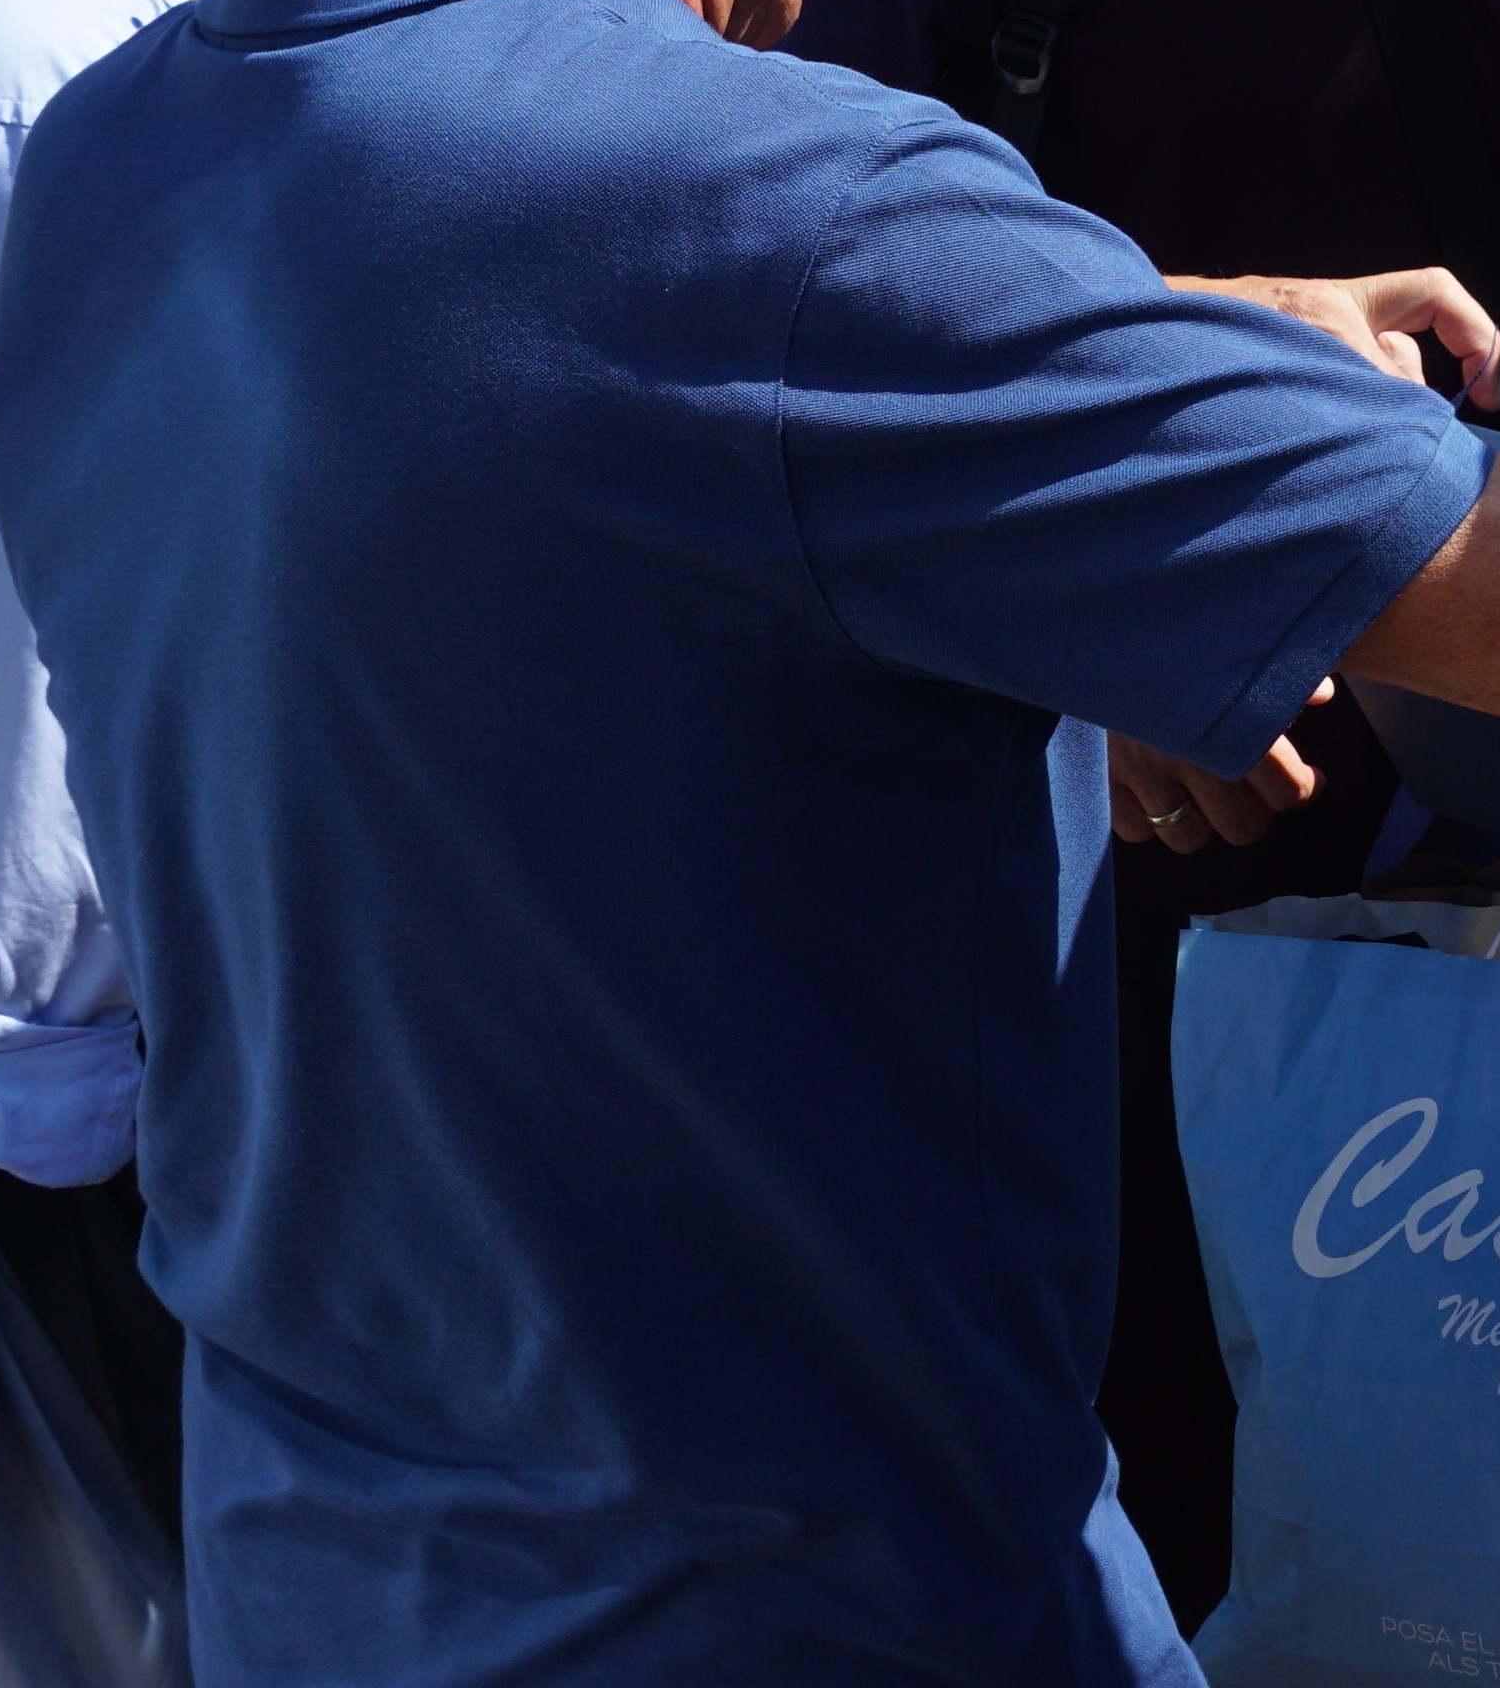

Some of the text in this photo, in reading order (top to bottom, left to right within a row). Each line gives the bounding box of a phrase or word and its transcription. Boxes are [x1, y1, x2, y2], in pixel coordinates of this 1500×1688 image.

[1380, 1616, 1455, 1647] POSA
[1461, 1631, 1495, 1656] EL
[1428, 1651, 1481, 1677] ALS
